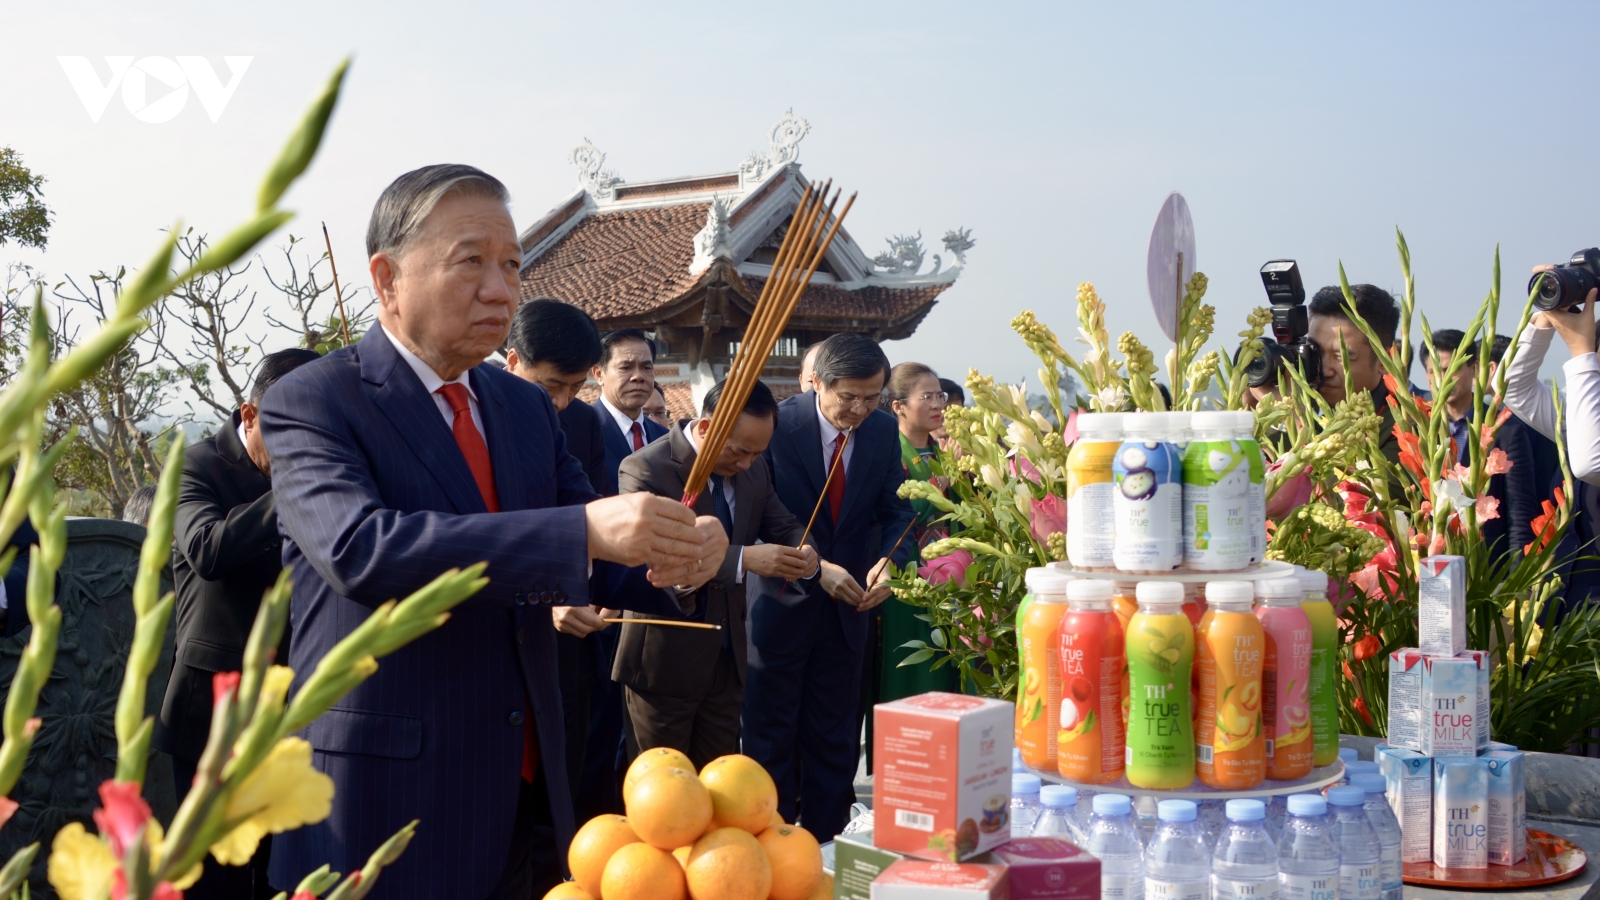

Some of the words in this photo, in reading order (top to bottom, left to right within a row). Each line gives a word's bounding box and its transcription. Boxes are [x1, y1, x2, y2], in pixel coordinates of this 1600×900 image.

[1130, 509, 1141, 517] TH
[1227, 508, 1238, 516] TH
[1129, 518, 1149, 527] true
[1227, 517, 1244, 526] true
[1061, 633, 1073, 646] TH
[1292, 629, 1305, 640] TH
[1233, 635, 1251, 647] TH
[1060, 645, 1084, 660] true
[1233, 647, 1260, 662] true
[1292, 642, 1311, 655] true
[1061, 659, 1084, 675] TEA
[1233, 661, 1258, 677] TEA
[1144, 685, 1166, 699] TH
[1144, 699, 1180, 717] true
[1435, 698, 1456, 710] TH
[1433, 711, 1473, 727] true
[1144, 717, 1182, 736] TEA
[1434, 727, 1473, 741] MILK
[1448, 808, 1469, 820] TH
[1447, 820, 1486, 837] true
[1447, 837, 1486, 851] MILK
[1358, 868, 1372, 877] TH
[1154, 884, 1166, 894] TH
[1310, 880, 1326, 889] TH
[1358, 877, 1379, 889] true
[1238, 885, 1254, 895] TH
[1310, 890, 1335, 900] true
